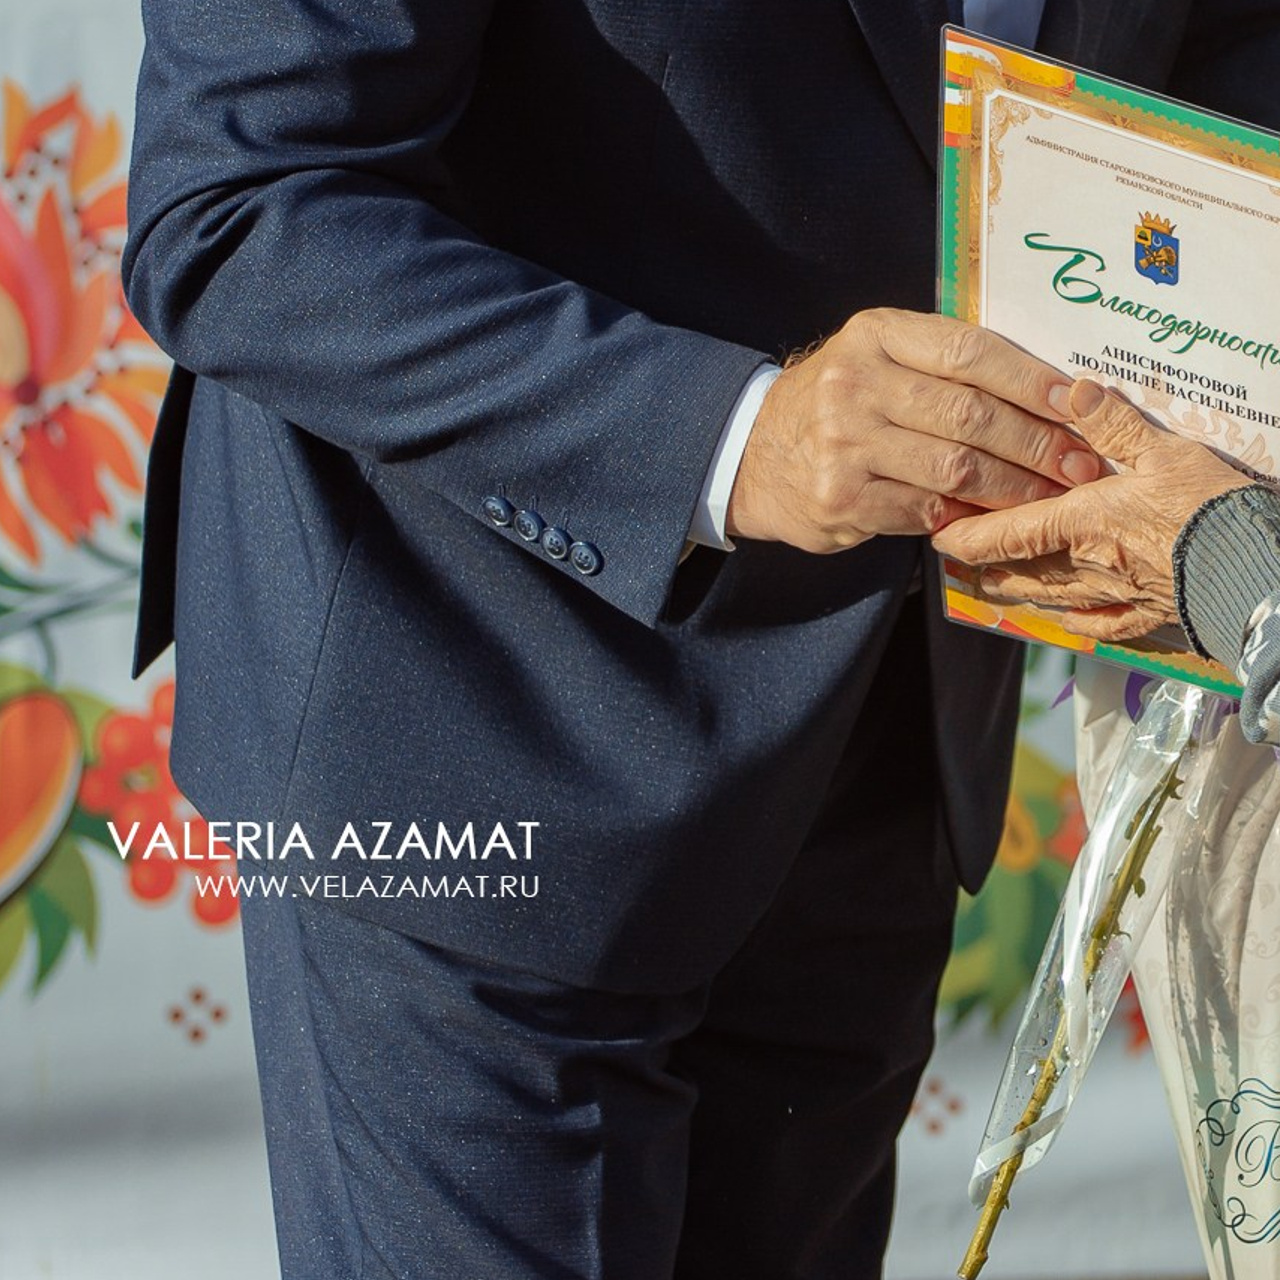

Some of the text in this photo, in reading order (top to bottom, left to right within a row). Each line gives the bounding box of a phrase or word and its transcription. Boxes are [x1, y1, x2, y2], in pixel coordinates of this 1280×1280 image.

[1025, 134, 1099, 165] АДМИНИСТРАЦИЯ
[1099, 159, 1182, 191] СТАРОЖИЛОВСКОГО
[1181, 186, 1263, 218] МУНИЦИПАЛЬНОГО
[1115, 175, 1203, 211] РЯЗАНСКОЙ ОБЛАСТИ
[1068, 351, 1161, 392] ЛЮДМИЛЕ
[1101, 344, 1248, 402] АНИСИФОРОВОЙ
